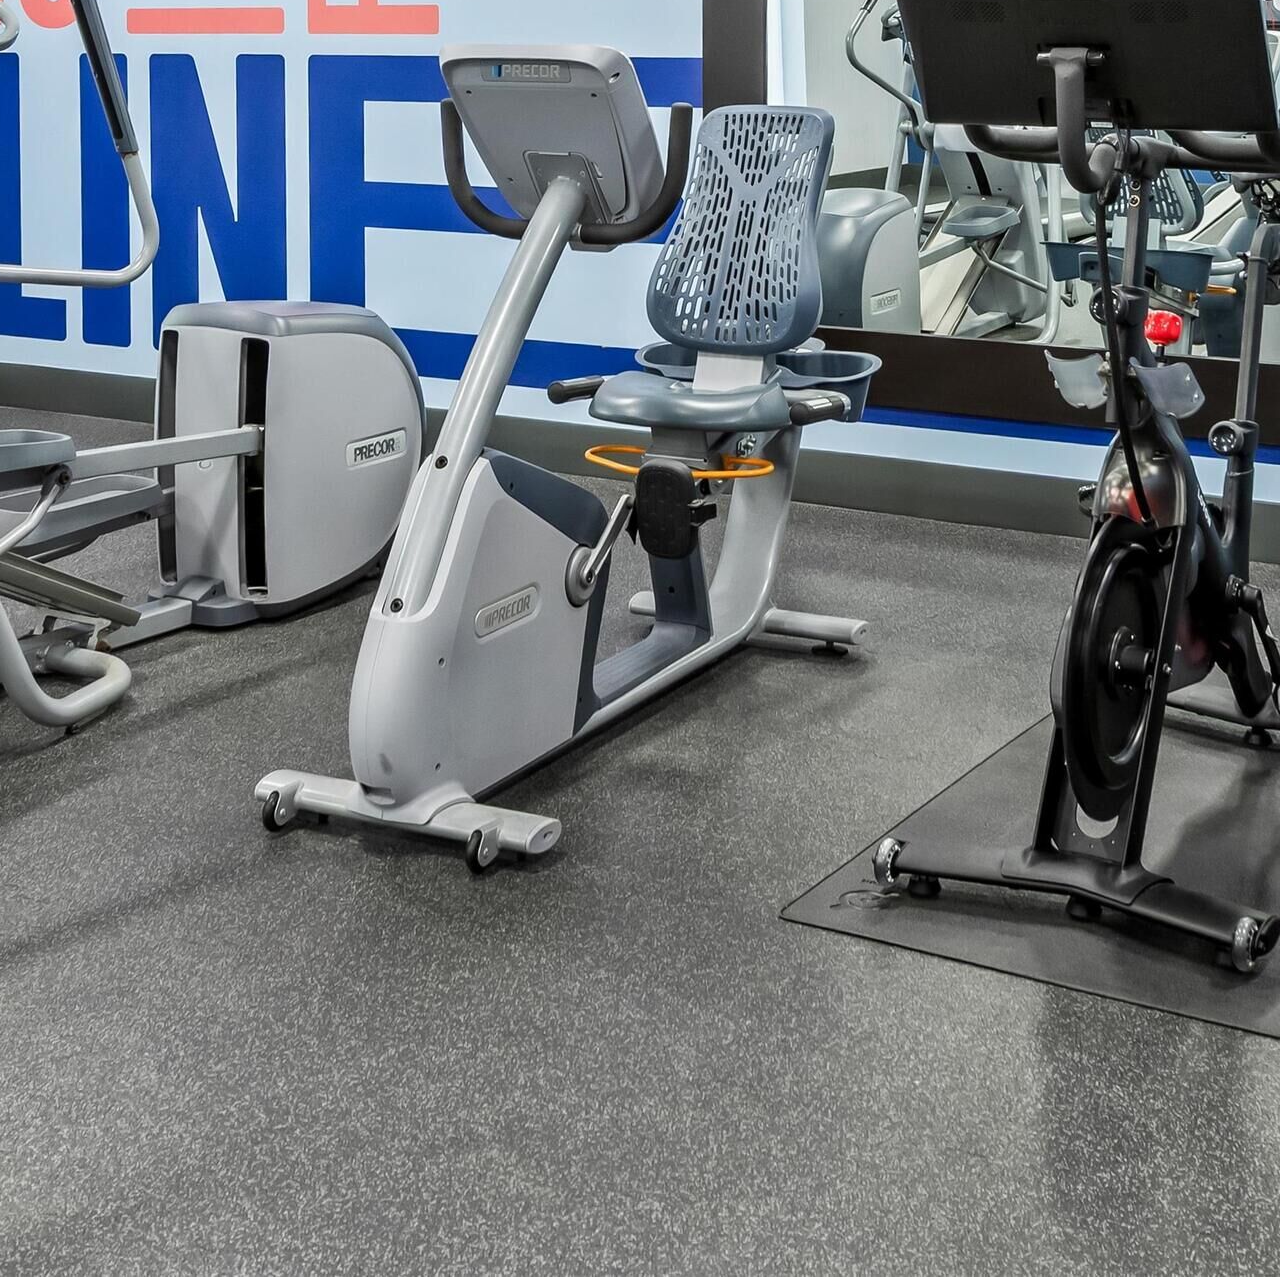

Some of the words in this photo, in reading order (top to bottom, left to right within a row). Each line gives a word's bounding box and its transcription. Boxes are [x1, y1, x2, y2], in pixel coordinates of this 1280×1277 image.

[501, 64, 561, 79] PRECOR
[352, 437, 396, 463] PRECOR
[489, 593, 531, 627] PRECOR
